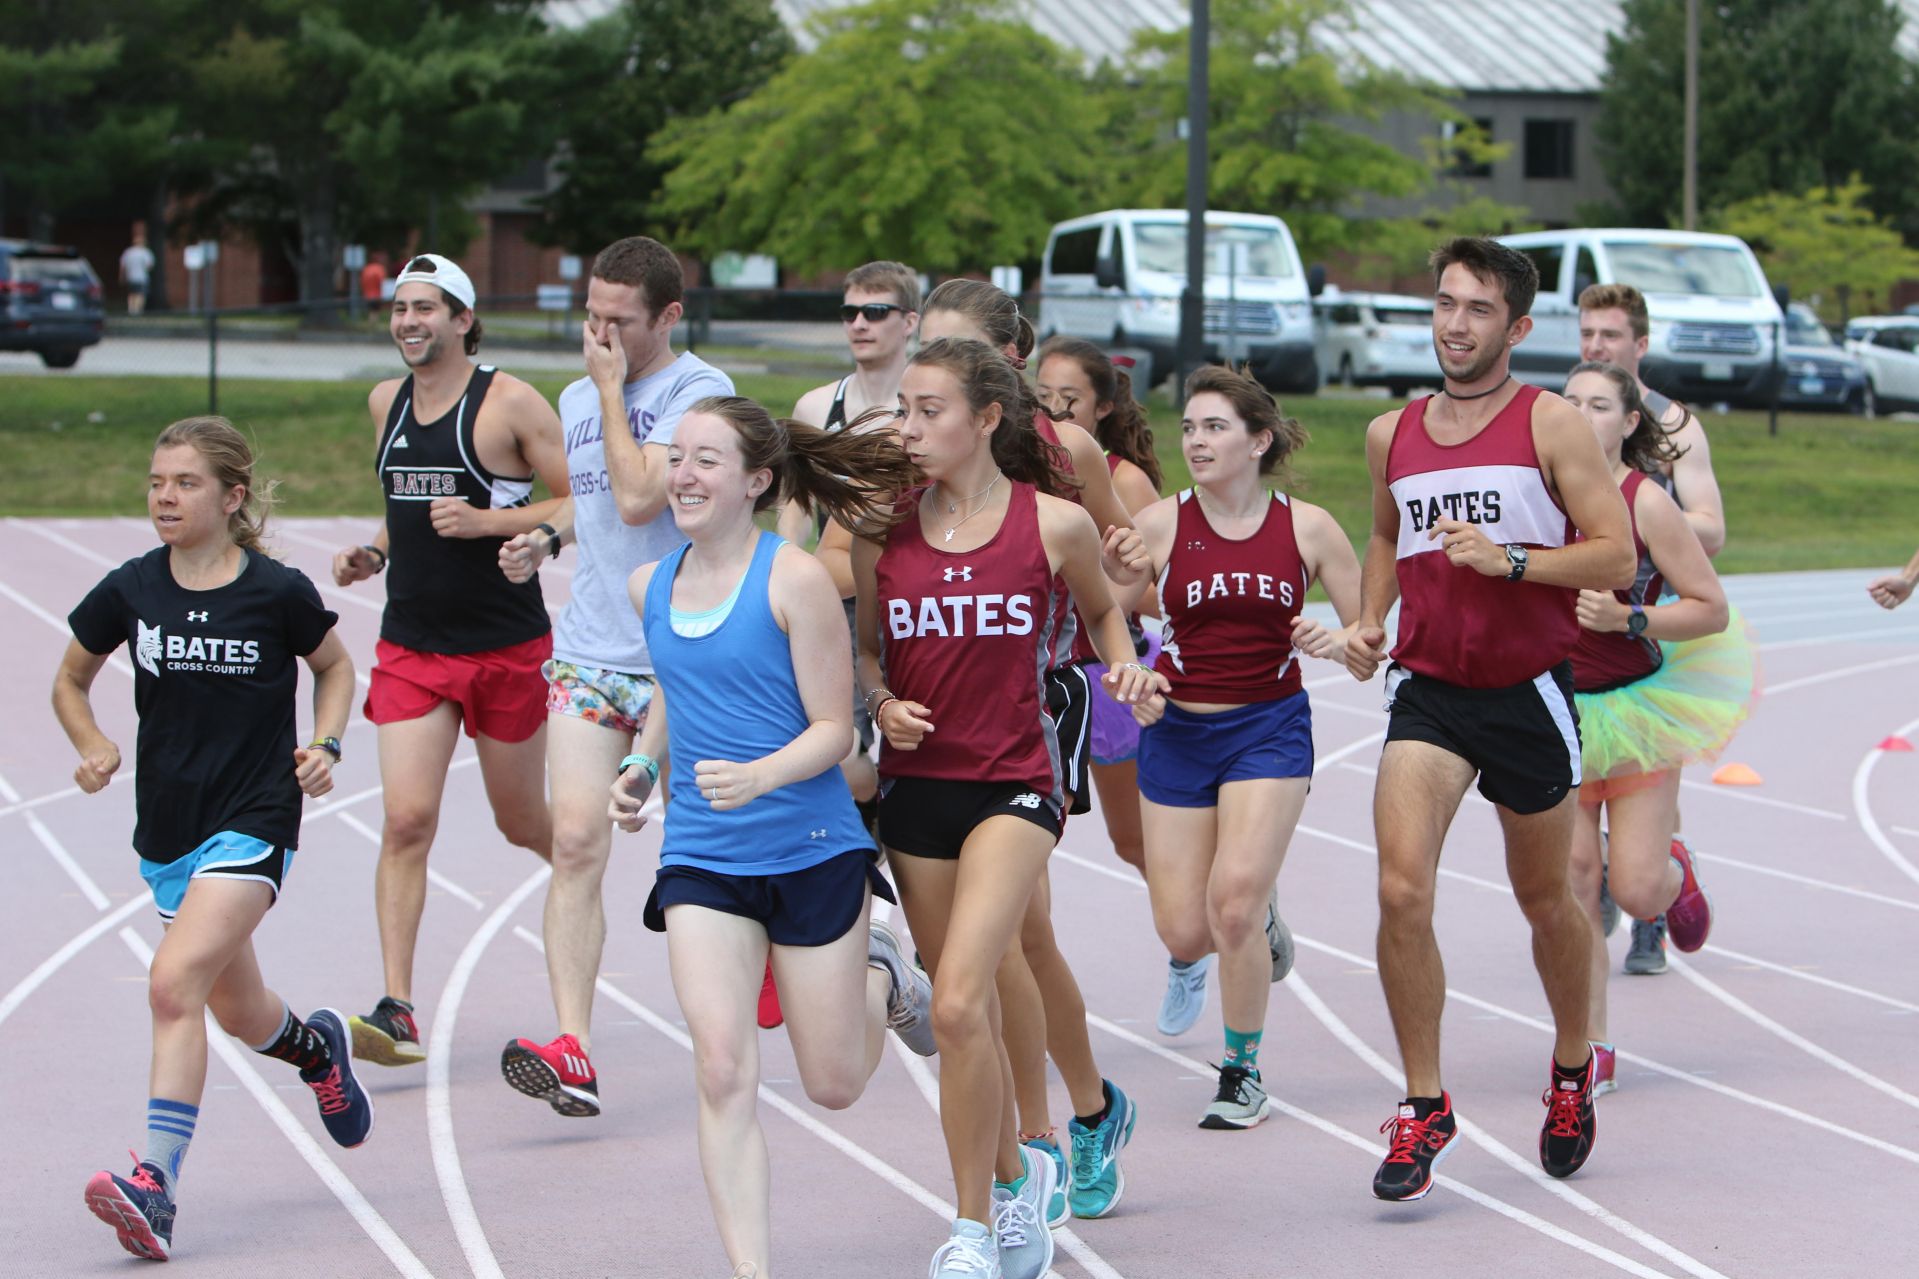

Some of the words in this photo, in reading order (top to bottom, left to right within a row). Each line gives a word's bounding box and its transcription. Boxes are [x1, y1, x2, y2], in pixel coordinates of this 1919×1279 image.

[392, 472, 456, 494] BATES
[1406, 490, 1501, 533] BATES
[1186, 572, 1294, 608] BATES
[888, 594, 1034, 640] BATES
[166, 635, 260, 664] BATES
[167, 661, 203, 671] CROSS
[205, 663, 256, 675] COUNTRY
